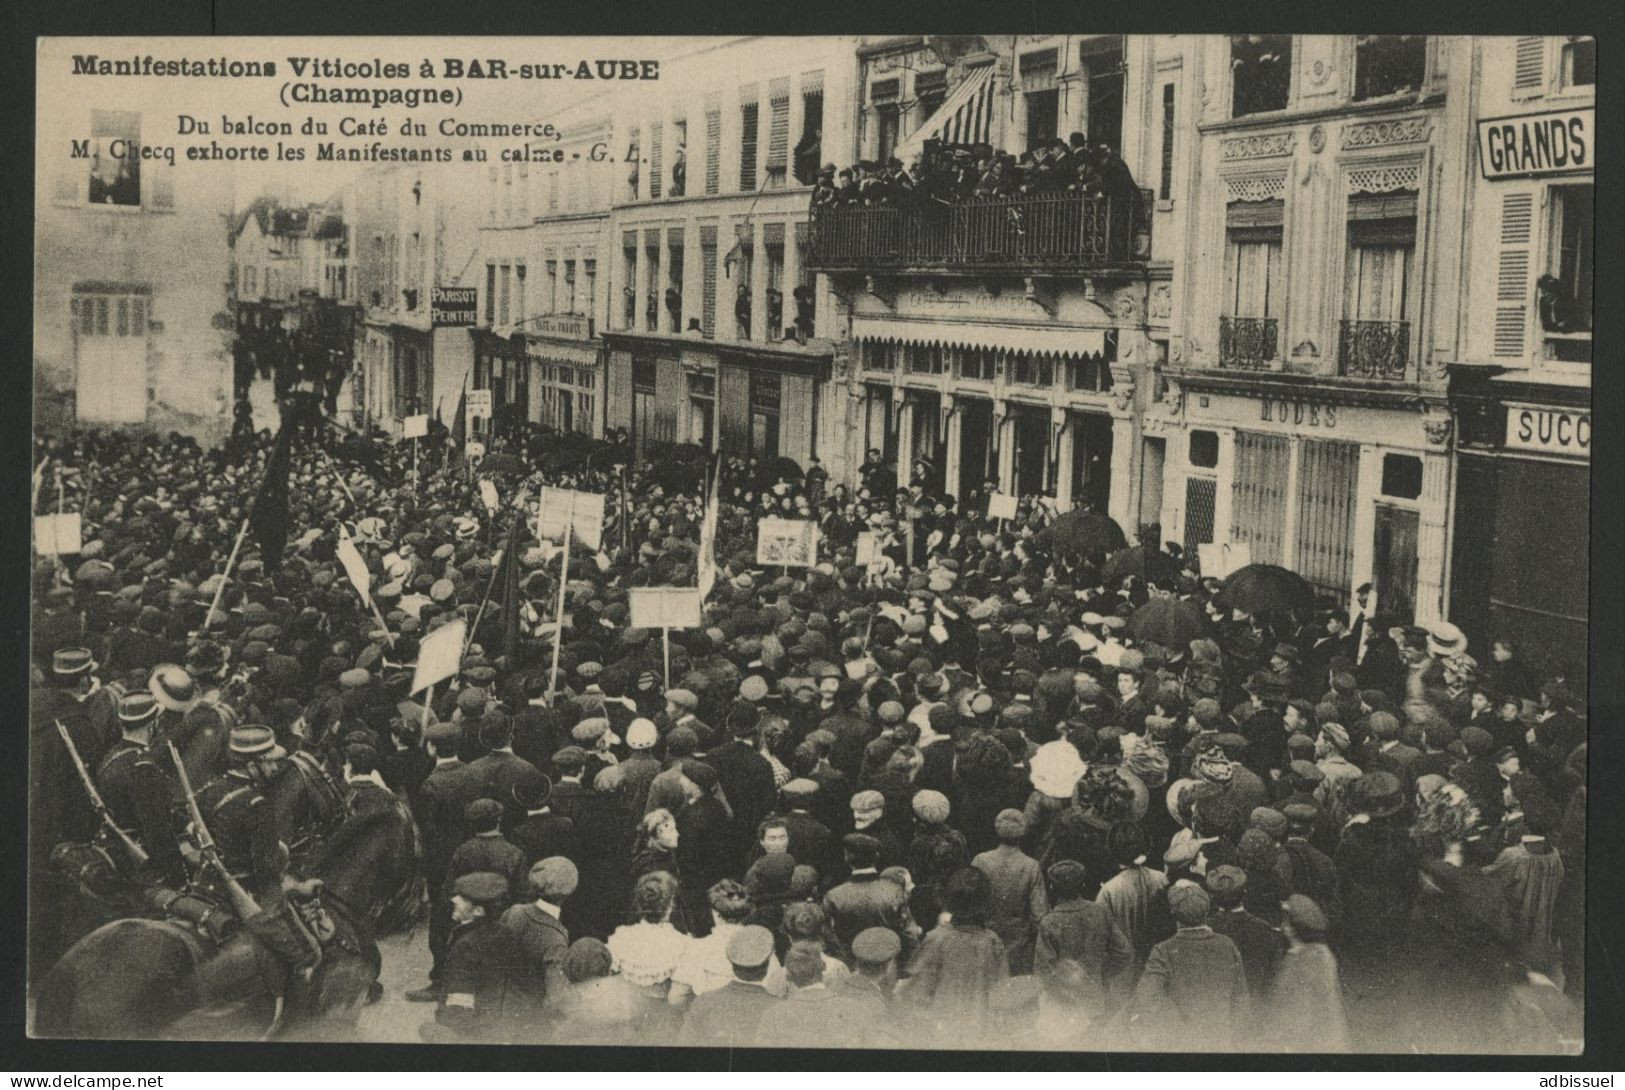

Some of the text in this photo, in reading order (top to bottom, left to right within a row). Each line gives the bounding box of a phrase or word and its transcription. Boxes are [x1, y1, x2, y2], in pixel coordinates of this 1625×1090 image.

[1488, 116, 1586, 172] GRANDS
[432, 288, 476, 303] PARISOT
[432, 308, 477, 322] PEINTRE
[1261, 398, 1337, 428] MODES
[1519, 411, 1590, 448] SUCC
